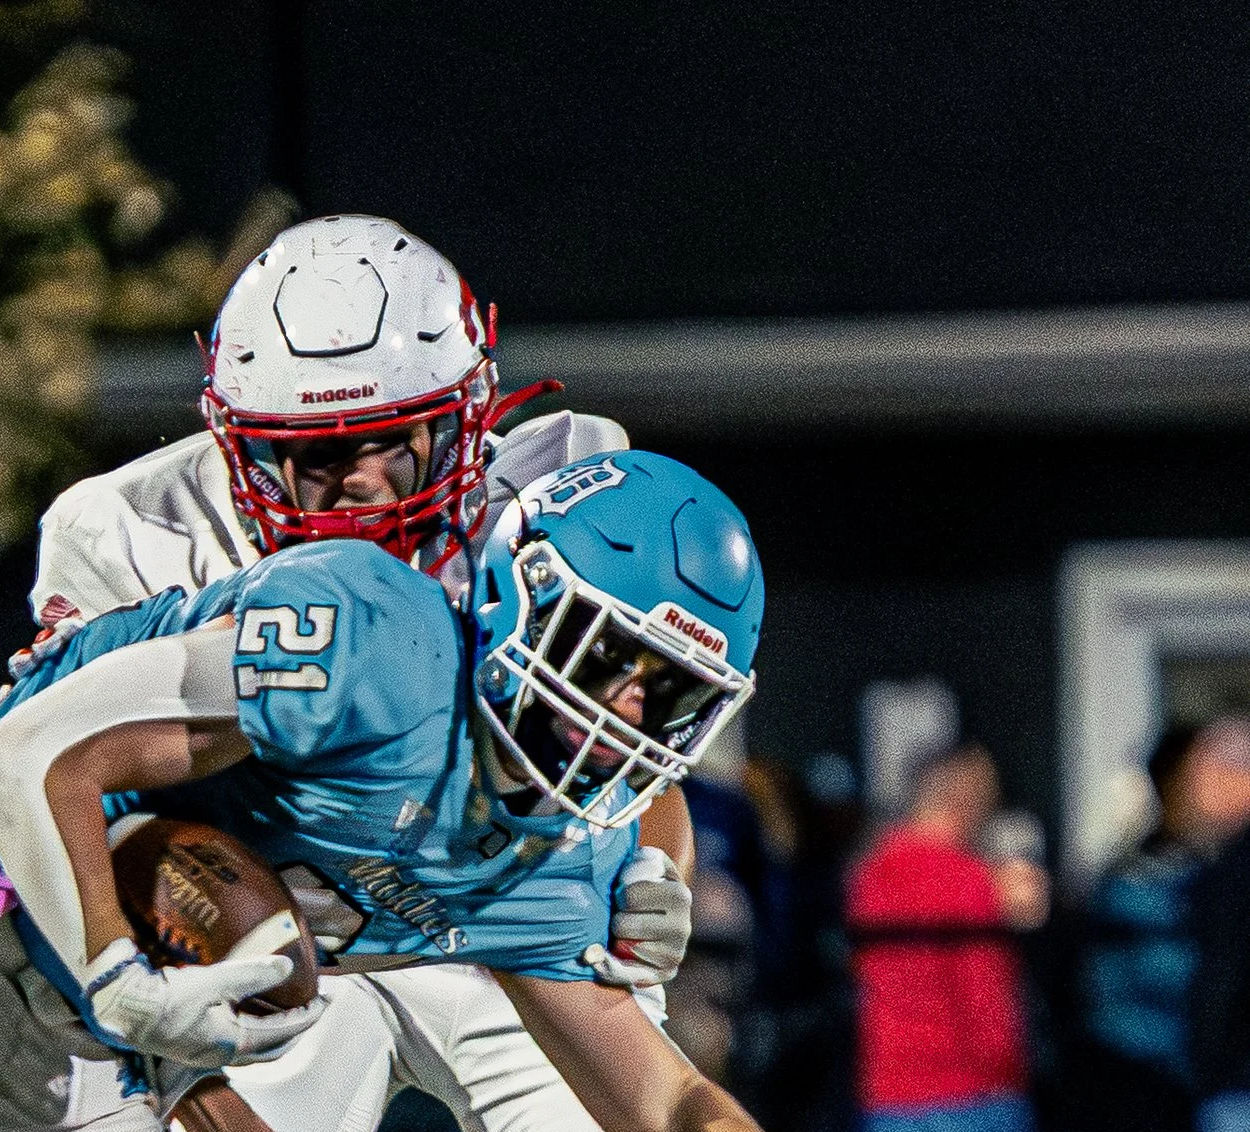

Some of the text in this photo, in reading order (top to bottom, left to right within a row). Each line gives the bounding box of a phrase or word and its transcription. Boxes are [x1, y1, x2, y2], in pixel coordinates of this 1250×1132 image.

[300, 382, 375, 404] Riddell
[233, 603, 339, 700] 21
[663, 608, 724, 653] Riddell
